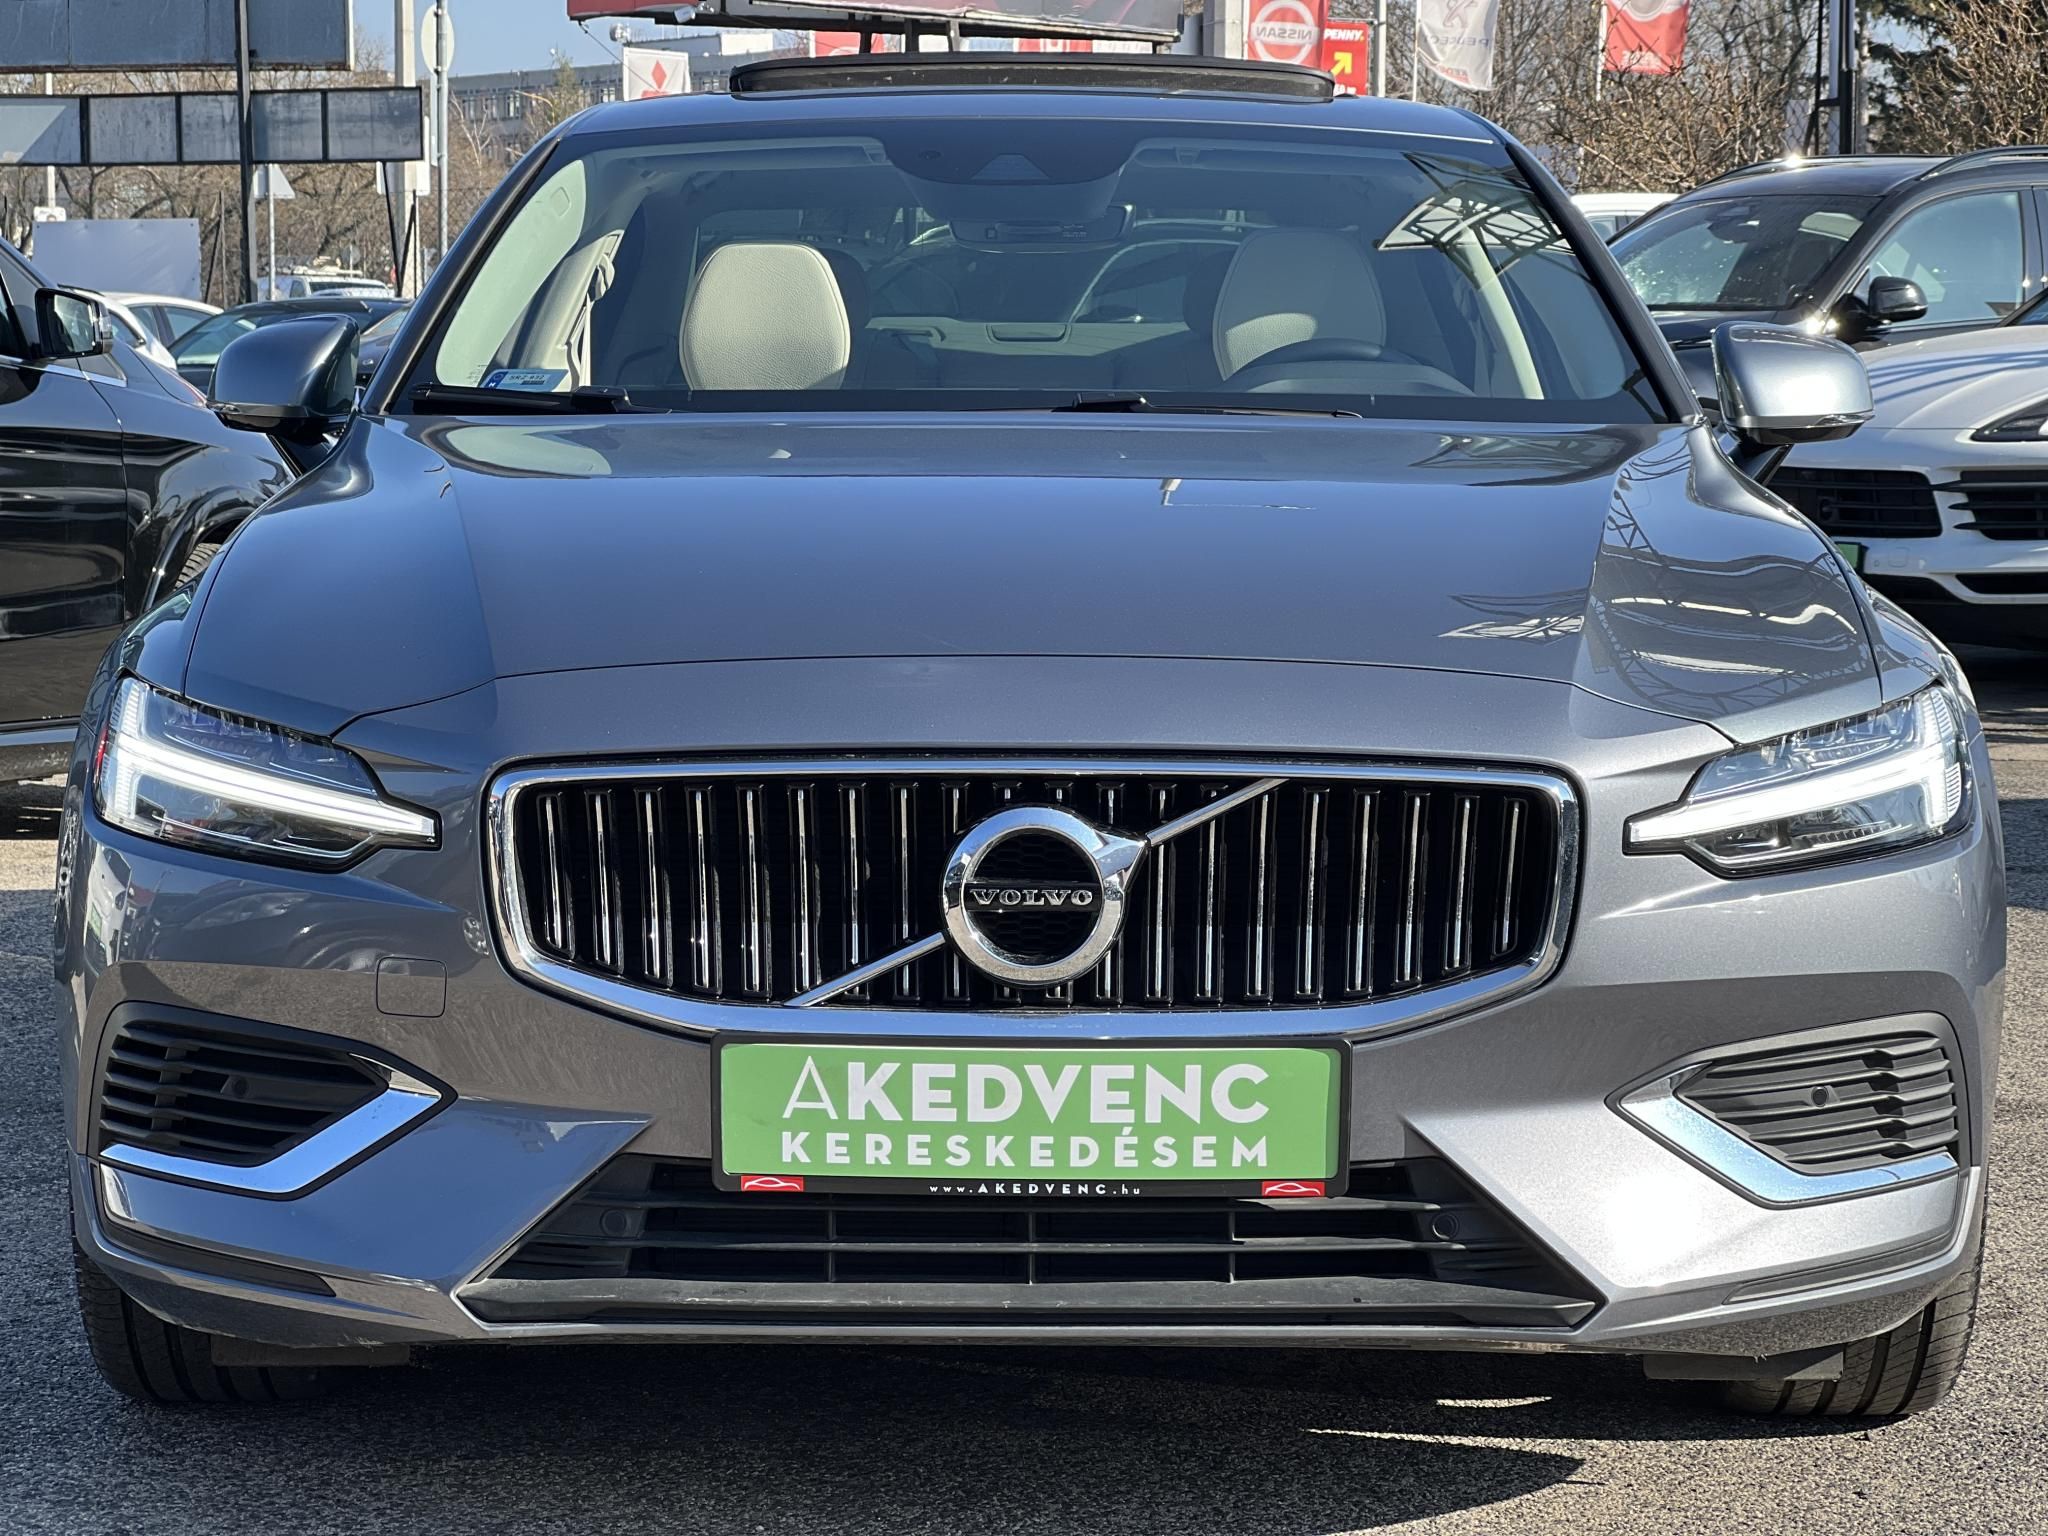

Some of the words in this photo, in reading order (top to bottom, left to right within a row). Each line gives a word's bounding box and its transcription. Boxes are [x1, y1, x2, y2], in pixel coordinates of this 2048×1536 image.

[969, 888, 1093, 906] VOLVO
[781, 1126, 1269, 1168] KERESKEDÉSEM
[929, 1182, 1141, 1195] www.AKEDVENC.hu
